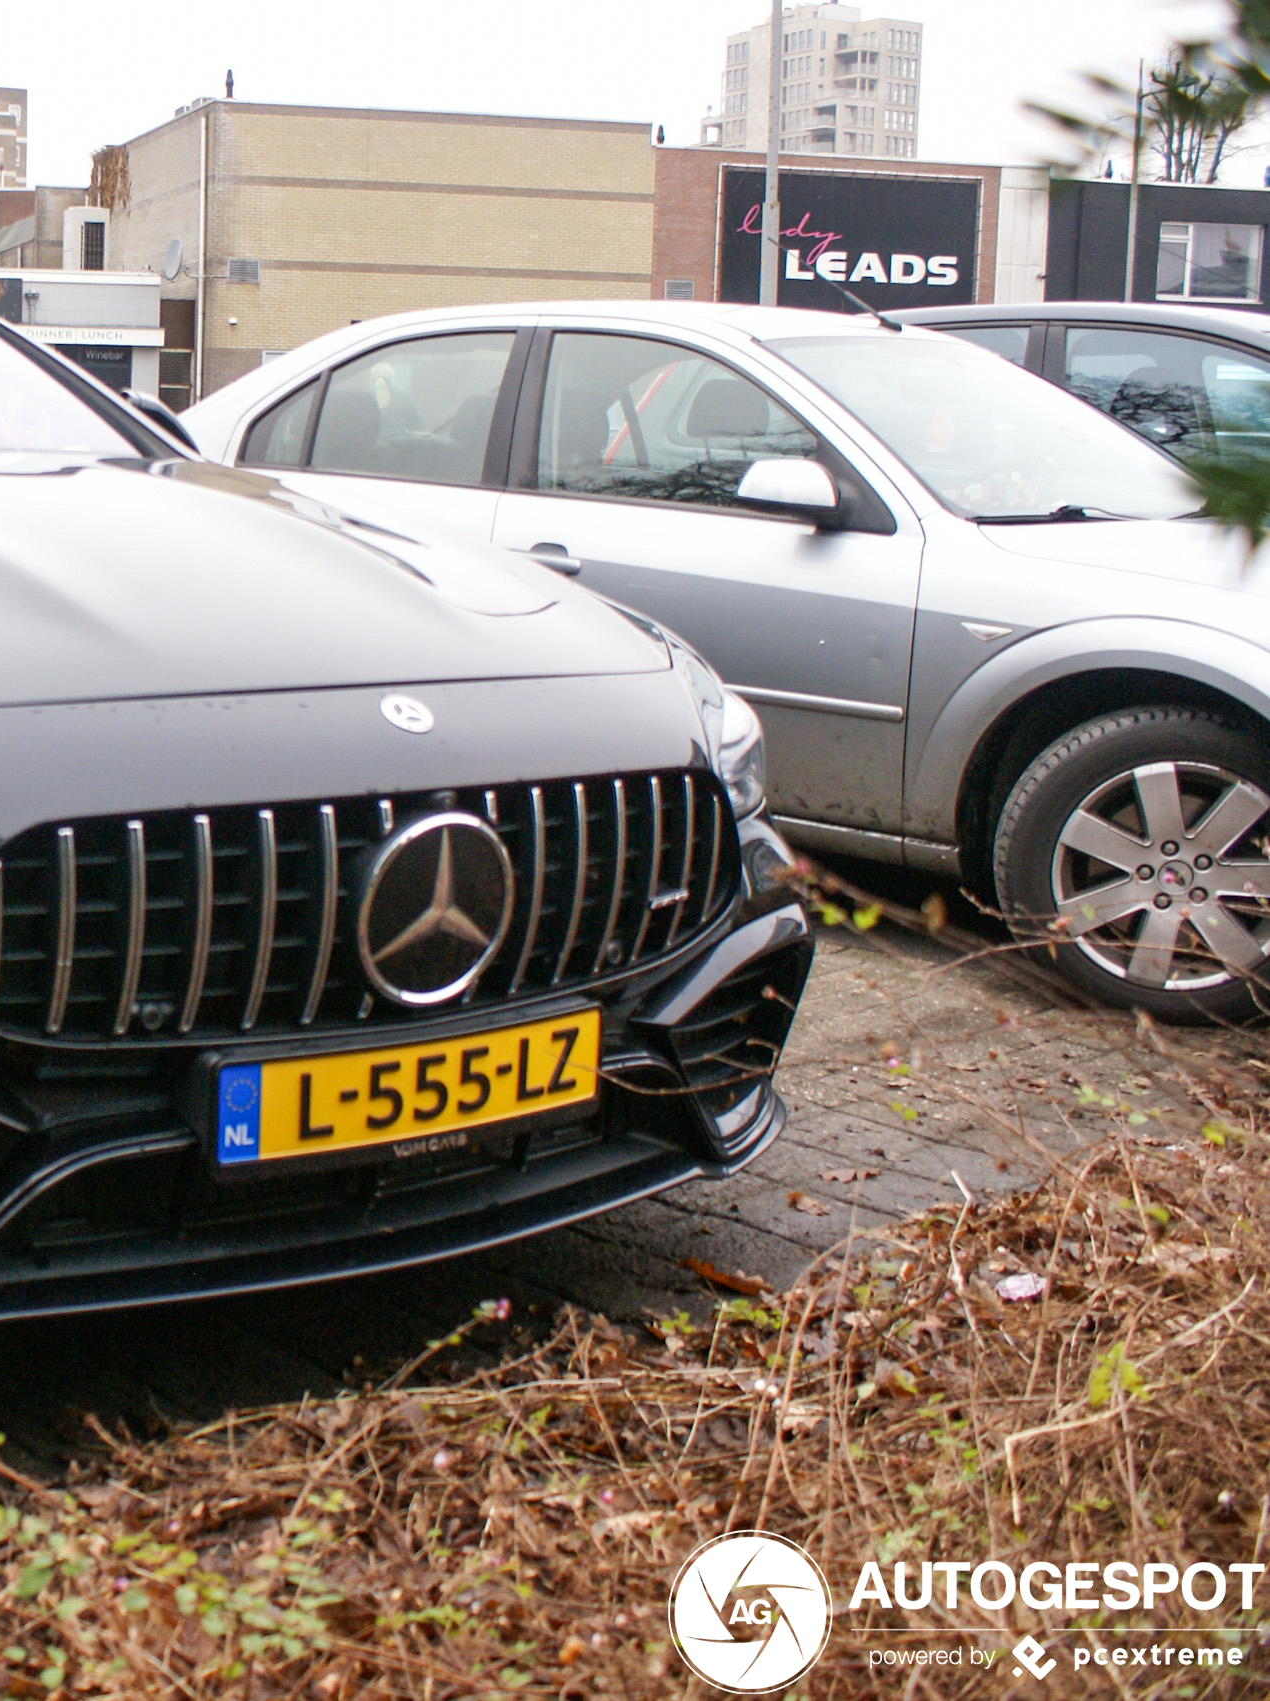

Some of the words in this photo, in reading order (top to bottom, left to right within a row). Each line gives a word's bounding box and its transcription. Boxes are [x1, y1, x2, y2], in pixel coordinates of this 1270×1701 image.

[736, 204, 842, 265] ldy
[785, 249, 958, 285] LEADS
[26, 329, 73, 339] DINNER
[81, 330, 124, 341] LUNCH
[85, 350, 125, 361] Winebar
[298, 1027, 580, 1141] L-555-LZ
[224, 1123, 255, 1148] NL
